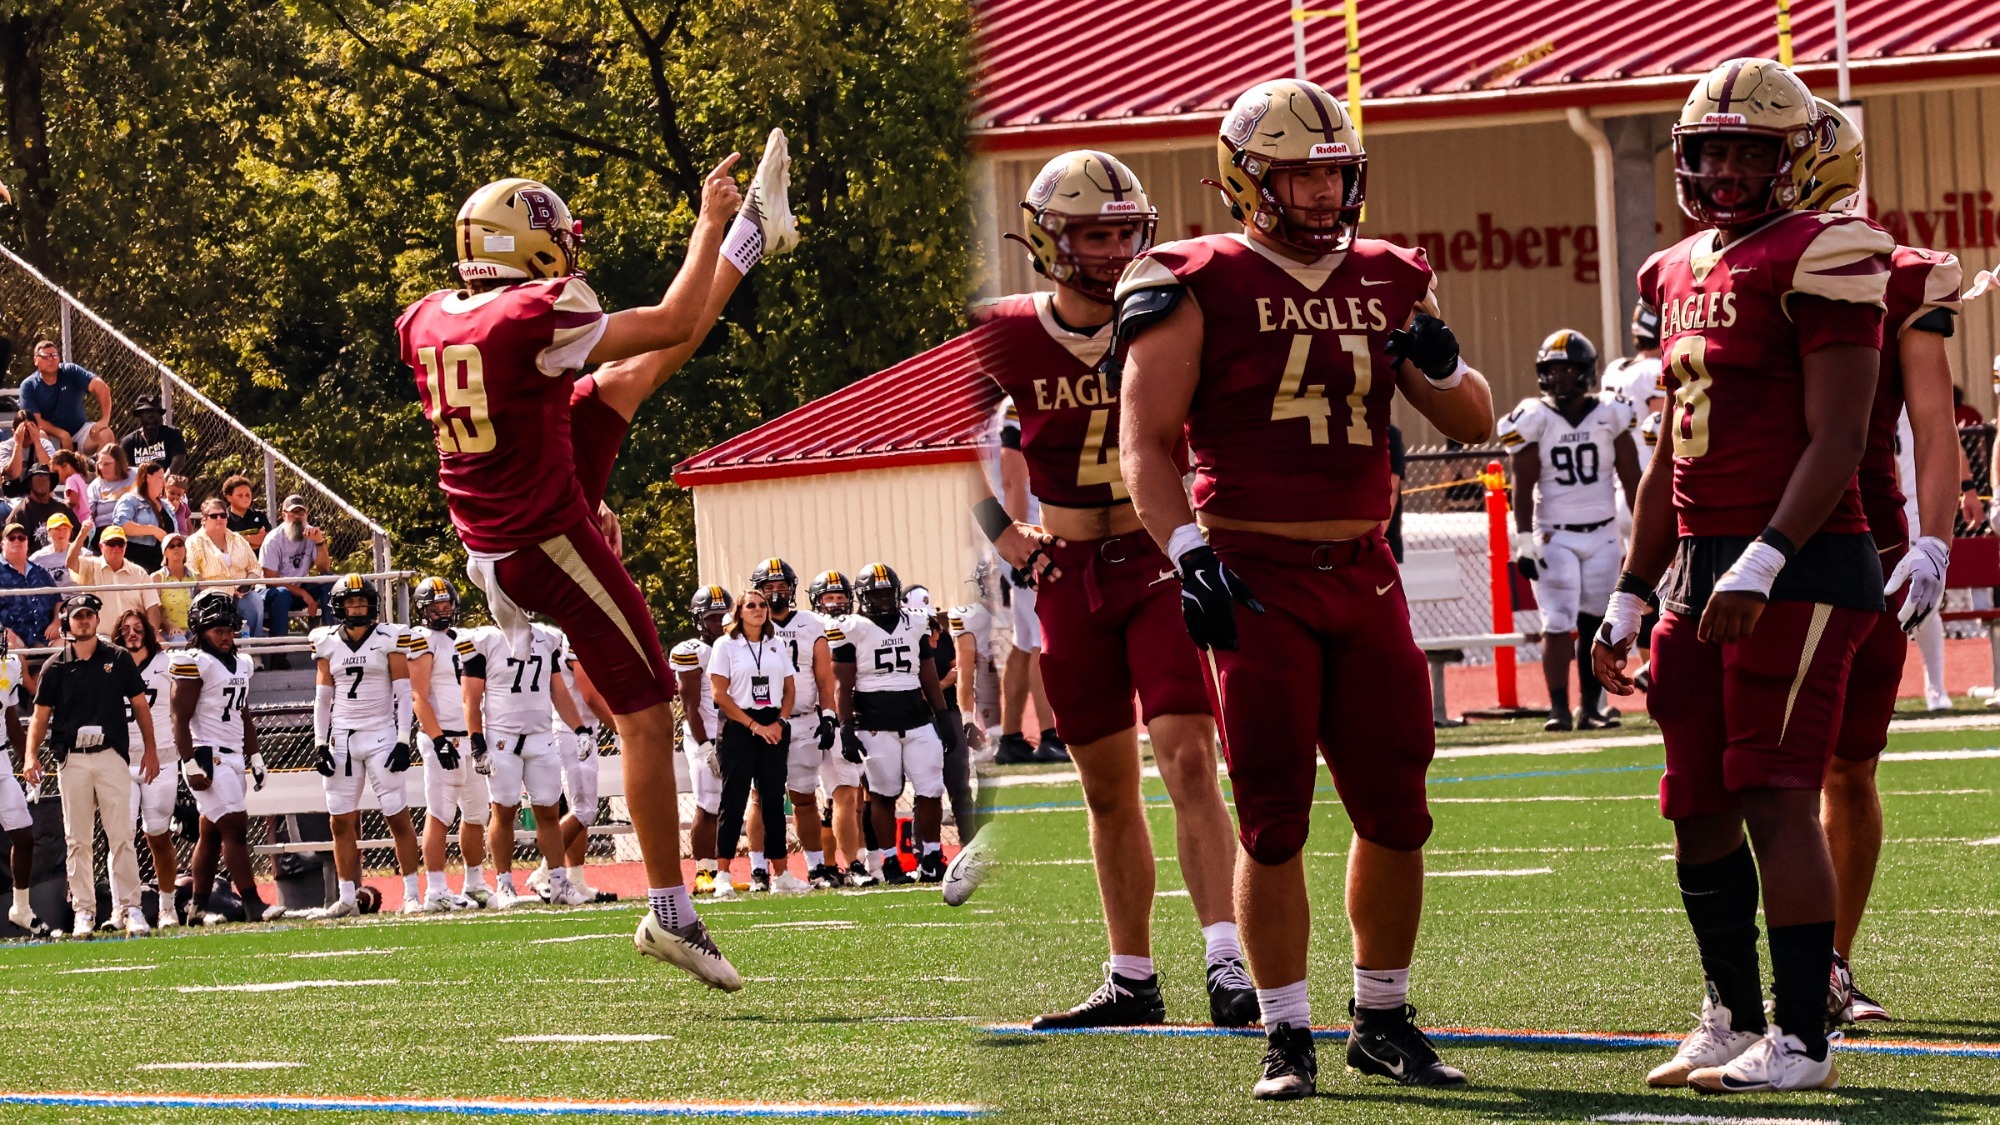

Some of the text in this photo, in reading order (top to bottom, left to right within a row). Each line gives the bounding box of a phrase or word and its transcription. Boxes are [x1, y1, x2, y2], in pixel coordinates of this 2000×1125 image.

[1706, 115, 1741, 124] Riddell
[1316, 144, 1347, 154] Riddell
[517, 189, 560, 230] B
[1866, 191, 2000, 249] avili
[1255, 297, 1387, 332] EAGLES
[1661, 291, 1737, 340] EAGLES
[418, 343, 497, 454] 19
[1033, 372, 1117, 410] EAGL
[1270, 333, 1373, 447] 41
[1671, 335, 1713, 458] 8
[134, 441, 165, 456] MACON
[1076, 408, 1130, 500] 4
[1558, 431, 1590, 443] JACKETS
[1550, 443, 1599, 485] 90
[775, 630, 796, 638] ACKETS
[881, 638, 904, 647] JACKETS
[342, 656, 367, 665] JACKETS
[506, 655, 543, 694] 77
[874, 645, 912, 674] 55
[345, 666, 364, 699] 7
